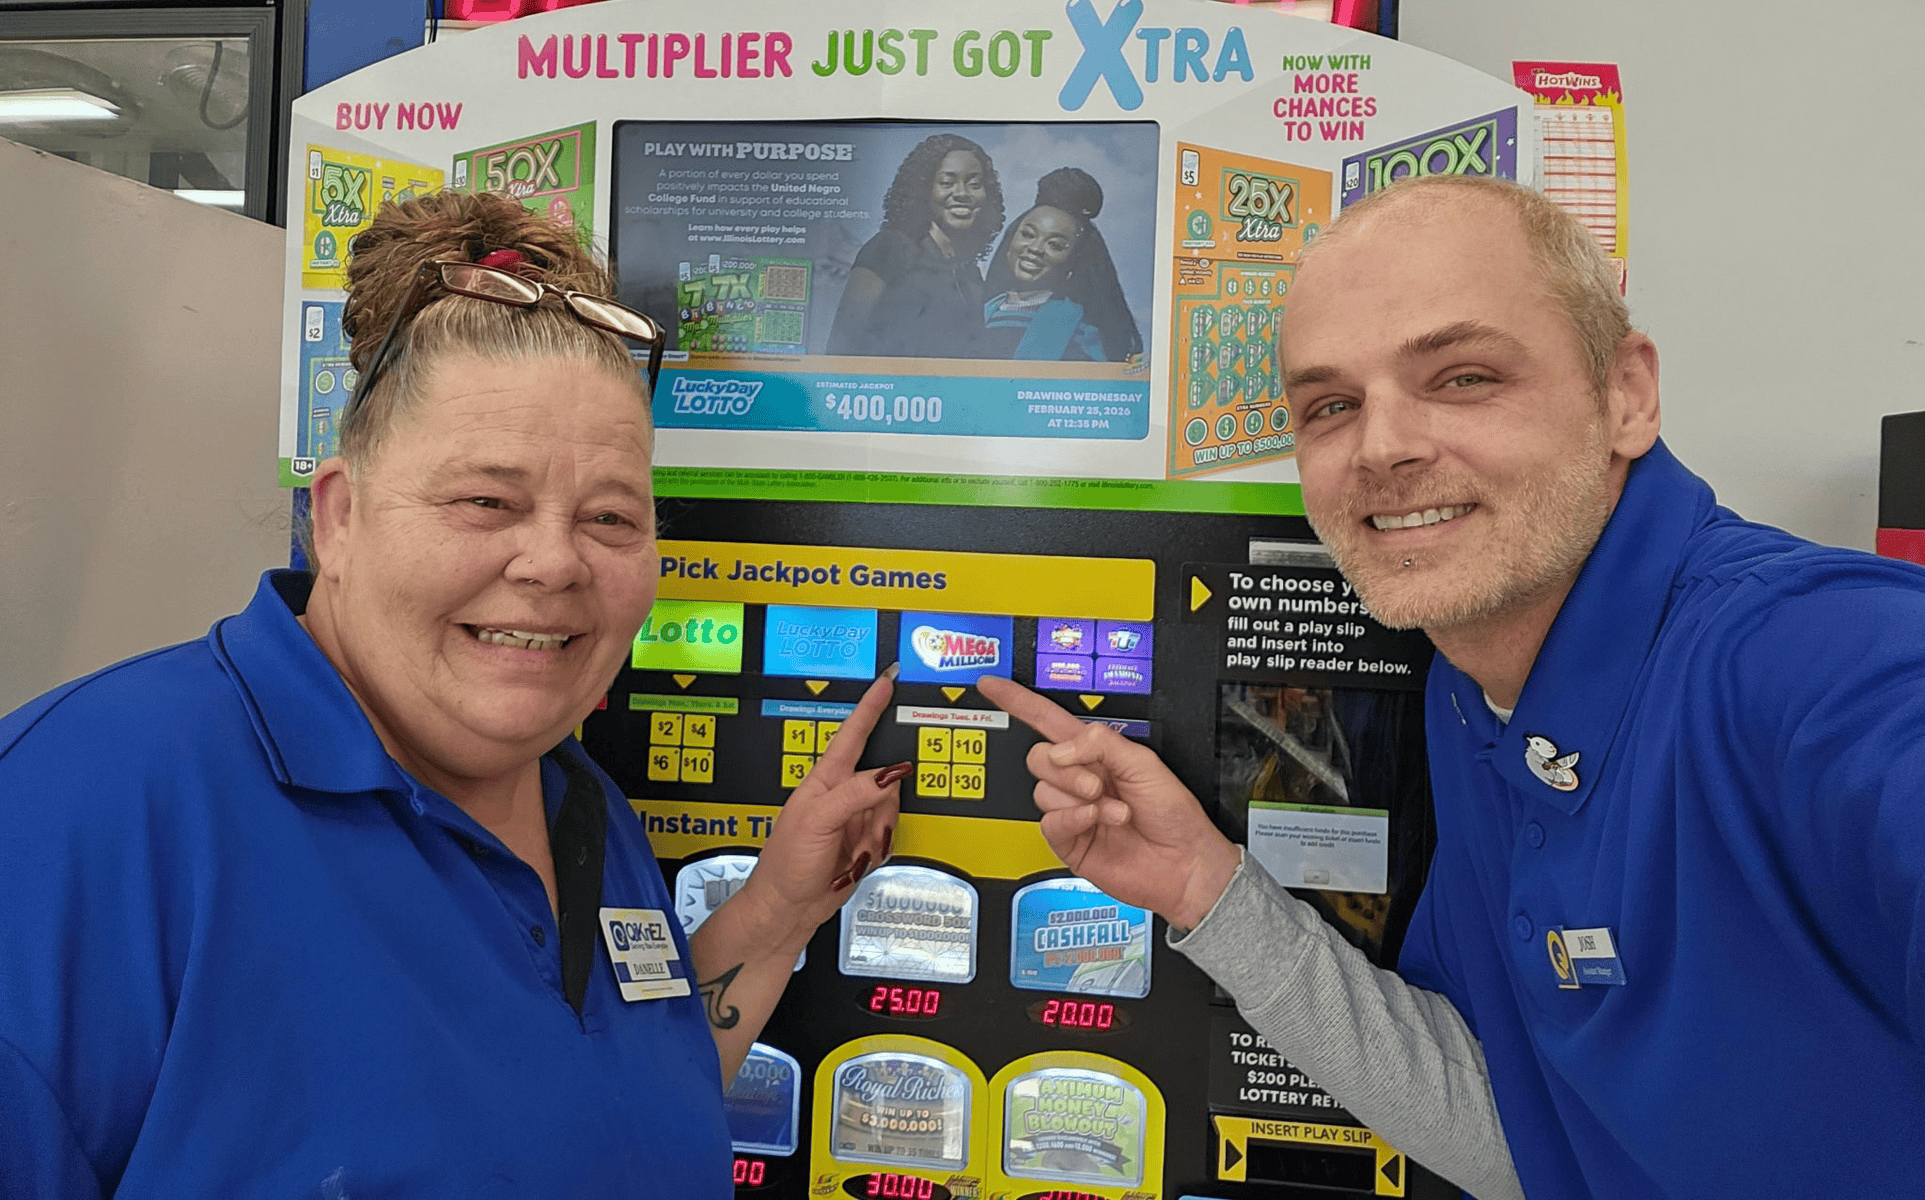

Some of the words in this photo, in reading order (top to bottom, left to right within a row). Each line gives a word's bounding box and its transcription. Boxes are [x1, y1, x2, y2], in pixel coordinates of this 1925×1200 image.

[517, 31, 794, 79] MULTIPLIER
[811, 29, 938, 77] JUST
[953, 29, 1053, 78] GOT
[1283, 55, 1323, 71] NOW
[1327, 54, 1371, 71] WITH
[1294, 73, 1359, 94] MORE
[335, 102, 388, 131] BUY
[397, 102, 463, 131] NOW
[1273, 96, 1377, 118] CHANCES
[1284, 120, 1318, 142] TO
[1323, 120, 1365, 141] WIN
[644, 142, 687, 156] PLAY
[688, 143, 734, 157] WITH
[736, 142, 853, 161] PURPOSE
[1369, 126, 1488, 188] 100X
[486, 139, 561, 193] 50X
[659, 169, 666, 178] A
[668, 168, 706, 180] portion
[708, 169, 720, 179] of
[721, 171, 750, 182] every
[752, 170, 783, 181] dollar
[784, 173, 804, 183] you
[806, 172, 839, 183] spend
[1184, 172, 1195, 184] $5
[321, 165, 367, 213] 5X
[656, 181, 705, 193] positively
[708, 182, 749, 194] impacts
[752, 182, 769, 192] the
[771, 183, 806, 193] United
[808, 184, 840, 196] Negro
[1229, 174, 1292, 222] 25X
[648, 193, 688, 205] College
[690, 194, 716, 204] Fund
[718, 195, 728, 204] in
[729, 196, 771, 207] support
[772, 195, 784, 205] of
[785, 196, 849, 207] educational
[325, 203, 360, 224] Xtra
[625, 205, 690, 217] scholarships
[692, 206, 707, 216] for
[708, 207, 758, 219] university
[760, 208, 781, 218] and
[783, 208, 821, 220] college
[688, 223, 714, 233] Learn
[714, 224, 734, 234] how
[735, 226, 759, 236] every
[761, 225, 780, 236] play
[781, 225, 806, 236] helps
[688, 234, 698, 243] at
[1237, 218, 1281, 240] Xtra
[309, 327, 320, 339] $2
[673, 377, 763, 397] LuckyDay
[816, 381, 858, 390] ESTIMATED
[858, 382, 895, 391] JACKPOT
[675, 395, 752, 414] LOTTO
[1017, 390, 1072, 402] DRAWING
[1073, 391, 1142, 403] WEDNESDAY
[825, 393, 943, 426] $400,000
[1028, 404, 1085, 415] FEBRUARY
[1086, 405, 1102, 417] 25,
[1104, 406, 1131, 416] 2026
[1048, 418, 1062, 429] AT
[1092, 420, 1110, 430] PM
[1194, 446, 1218, 464] WIN
[1219, 443, 1236, 460] UP
[1237, 440, 1252, 455] TO
[1253, 432, 1294, 452] $500,00
[294, 460, 313, 470] 18+
[660, 556, 719, 580] Pick
[727, 559, 841, 587] Jackpot
[849, 563, 946, 592] Games
[1229, 572, 1254, 590] To
[1260, 574, 1335, 593] choose
[1228, 596, 1272, 612] own
[640, 615, 739, 645] Lotto
[776, 621, 871, 640] LuckyDay
[1227, 616, 1248, 631] fill
[1252, 618, 1280, 632] out
[1284, 621, 1294, 633] a
[1298, 620, 1333, 637] play
[1336, 622, 1366, 638] slip
[778, 638, 859, 658] LOTTO
[944, 633, 997, 657] MEGA
[1227, 636, 1257, 649] and
[1262, 636, 1307, 651] insert
[1312, 638, 1345, 653] into
[939, 654, 996, 668] MILLIONS
[1226, 653, 1261, 668] play
[1266, 653, 1296, 671] slip
[1300, 657, 1353, 673] reader
[1358, 659, 1412, 675] below.
[779, 703, 816, 716] Drawings
[912, 711, 948, 723] Drawings
[951, 712, 971, 722] Tues.
[973, 714, 979, 723] &
[980, 714, 993, 723] Fri.
[658, 721, 674, 737] $2
[691, 722, 706, 738] $4
[792, 729, 806, 745] $1
[926, 737, 943, 753] $5
[956, 739, 983, 755] $10
[653, 754, 669, 770] $6
[684, 755, 709, 773] $10
[789, 763, 805, 779] $3
[920, 772, 947, 789] $20
[954, 774, 982, 791] $30
[639, 809, 738, 838] Instant
[857, 910, 942, 927] CROSSWORD
[943, 916, 971, 928] 50X
[856, 925, 879, 937] WIN
[894, 928, 907, 940] TO
[1035, 919, 1132, 951] CASHFALL
[870, 987, 940, 1015] 25.00
[1042, 1000, 1114, 1029] 20.00
[1230, 1032, 1253, 1047] TO
[842, 1065, 900, 1101] Royal
[1247, 1070, 1286, 1086] $200
[1039, 1078, 1123, 1103] AXIMUM
[1240, 1088, 1309, 1105] LOTTERY
[876, 1105, 896, 1116] WIN
[899, 1107, 912, 1118] UP
[915, 1109, 930, 1119] TO
[1038, 1097, 1105, 1118] MONEY
[1027, 1114, 1118, 1138] BLOWOUT
[1251, 1122, 1300, 1138] INSERT
[1304, 1126, 1339, 1141] PLAY
[1343, 1130, 1372, 1144] SLIP
[867, 1172, 933, 1200] 30.00
